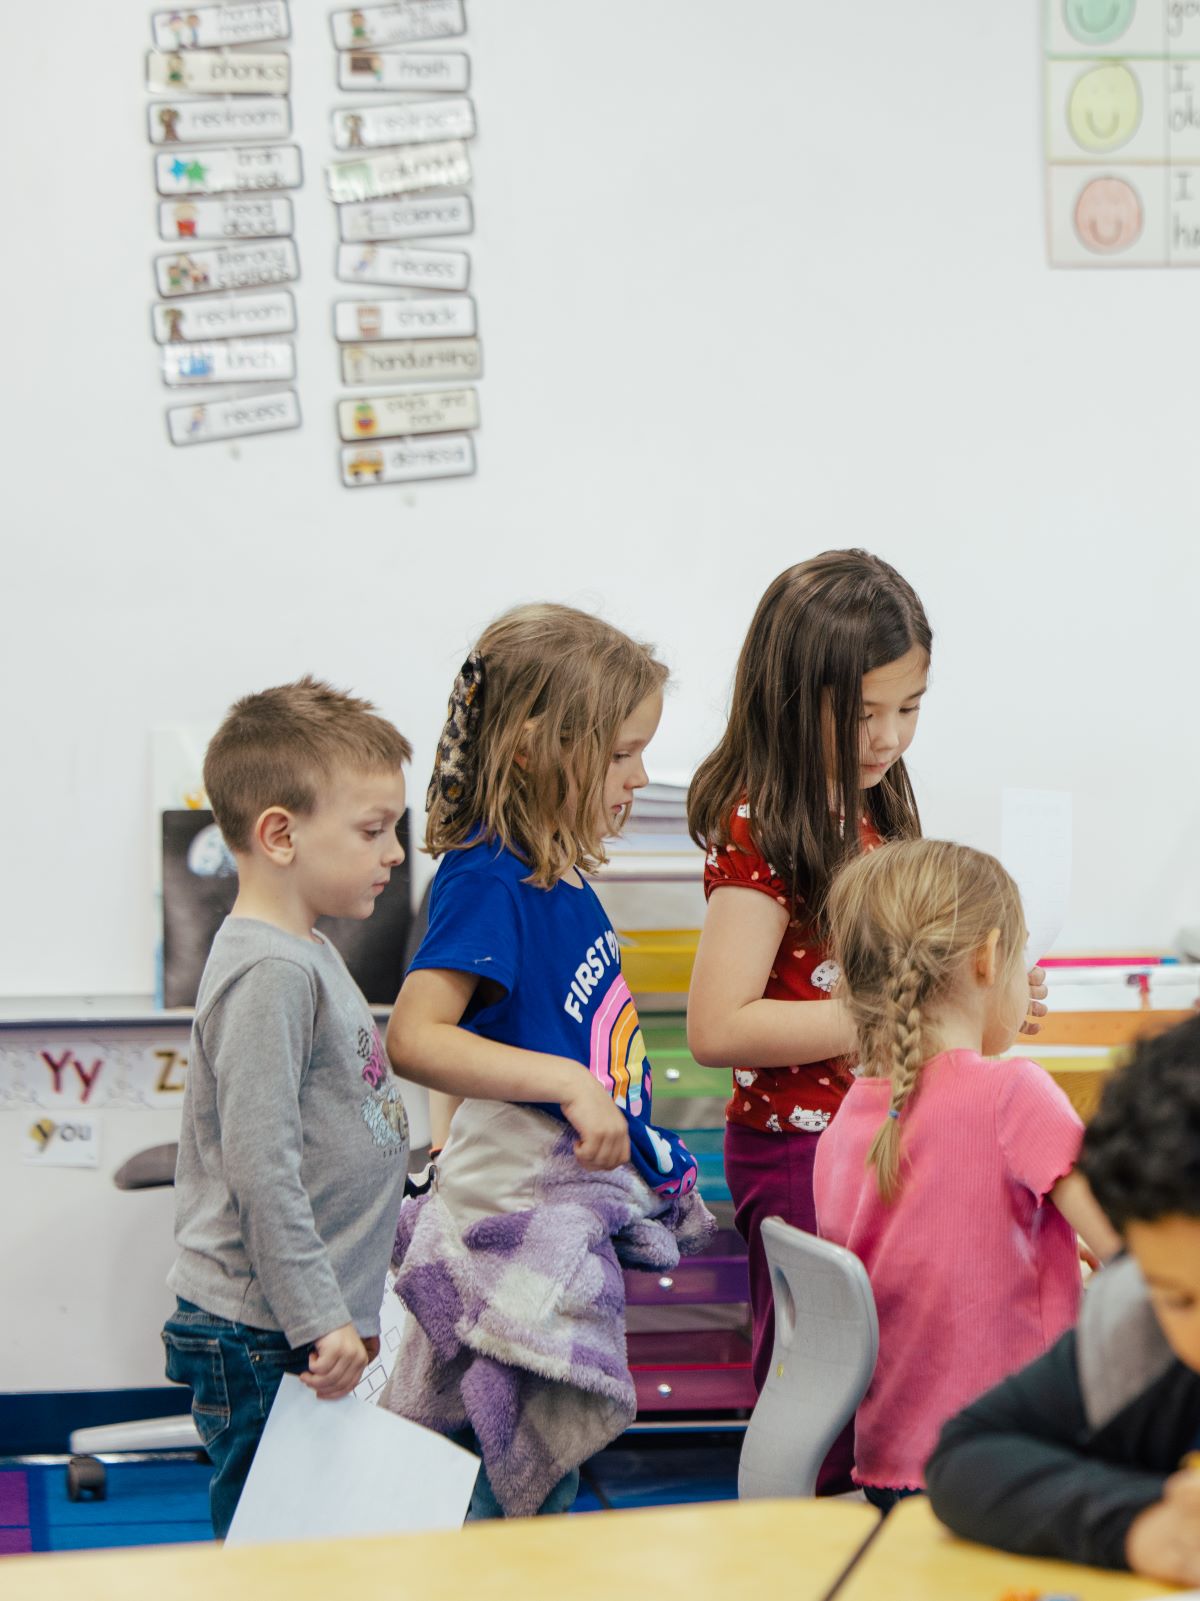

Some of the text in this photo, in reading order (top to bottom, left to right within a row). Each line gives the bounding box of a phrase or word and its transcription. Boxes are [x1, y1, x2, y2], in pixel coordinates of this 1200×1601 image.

[210, 58, 288, 81] phonics
[1171, 63, 1194, 93] I
[192, 107, 282, 128] restroom
[1173, 170, 1194, 202] I
[391, 206, 462, 227] science
[391, 257, 457, 278] recess
[193, 304, 286, 326] restroom
[397, 306, 457, 326] snack
[225, 350, 276, 369] lunch
[369, 350, 477, 373] handwriting
[223, 403, 286, 425] recess
[564, 936, 611, 1024] FIRST
[38, 1049, 104, 1103] Yy
